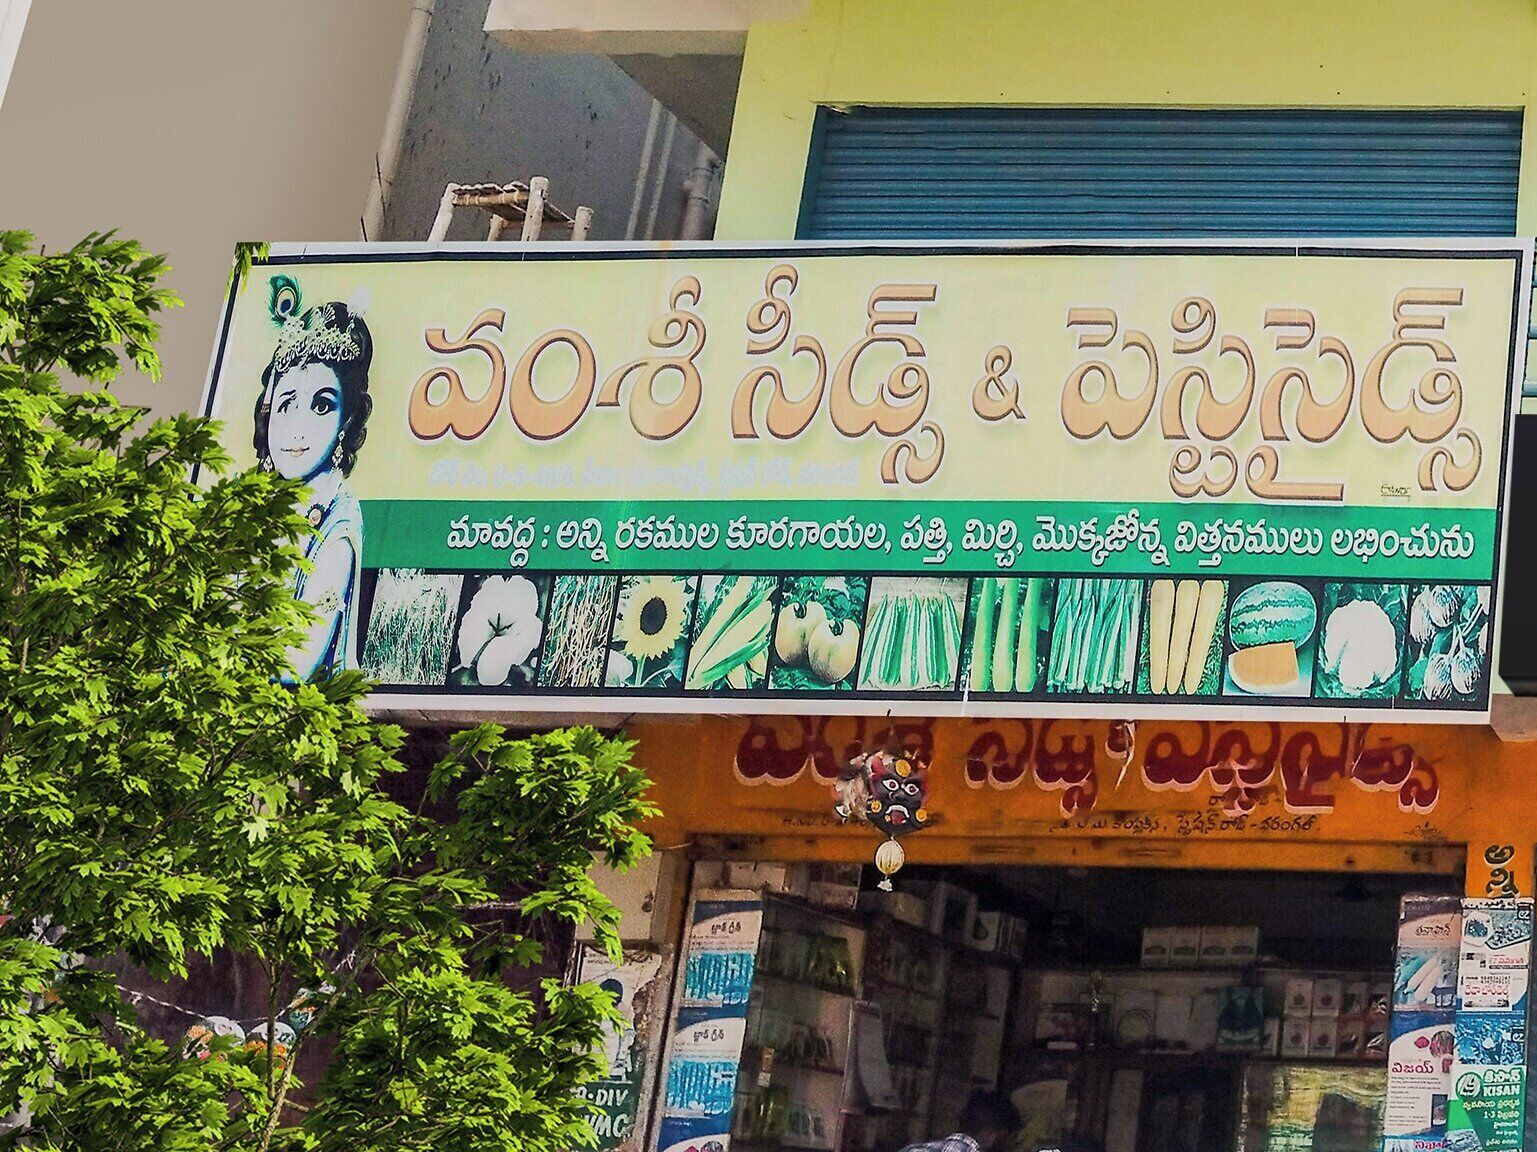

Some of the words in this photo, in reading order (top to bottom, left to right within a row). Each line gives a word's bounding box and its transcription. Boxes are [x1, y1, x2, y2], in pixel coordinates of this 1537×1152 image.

[407, 274, 708, 441] వంశీ
[730, 262, 947, 486] సీడ్స్
[971, 344, 1027, 422] &
[1060, 287, 1485, 503] పెస్టిసైడ్స్
[556, 517, 610, 563] అన్ని
[614, 515, 720, 550] రకముల
[725, 515, 892, 554] కూరగాయల,
[1174, 518, 1324, 566] విత్తనములు
[1330, 522, 1475, 564] లభించును
[1483, 1084, 1520, 1097] KISAN
